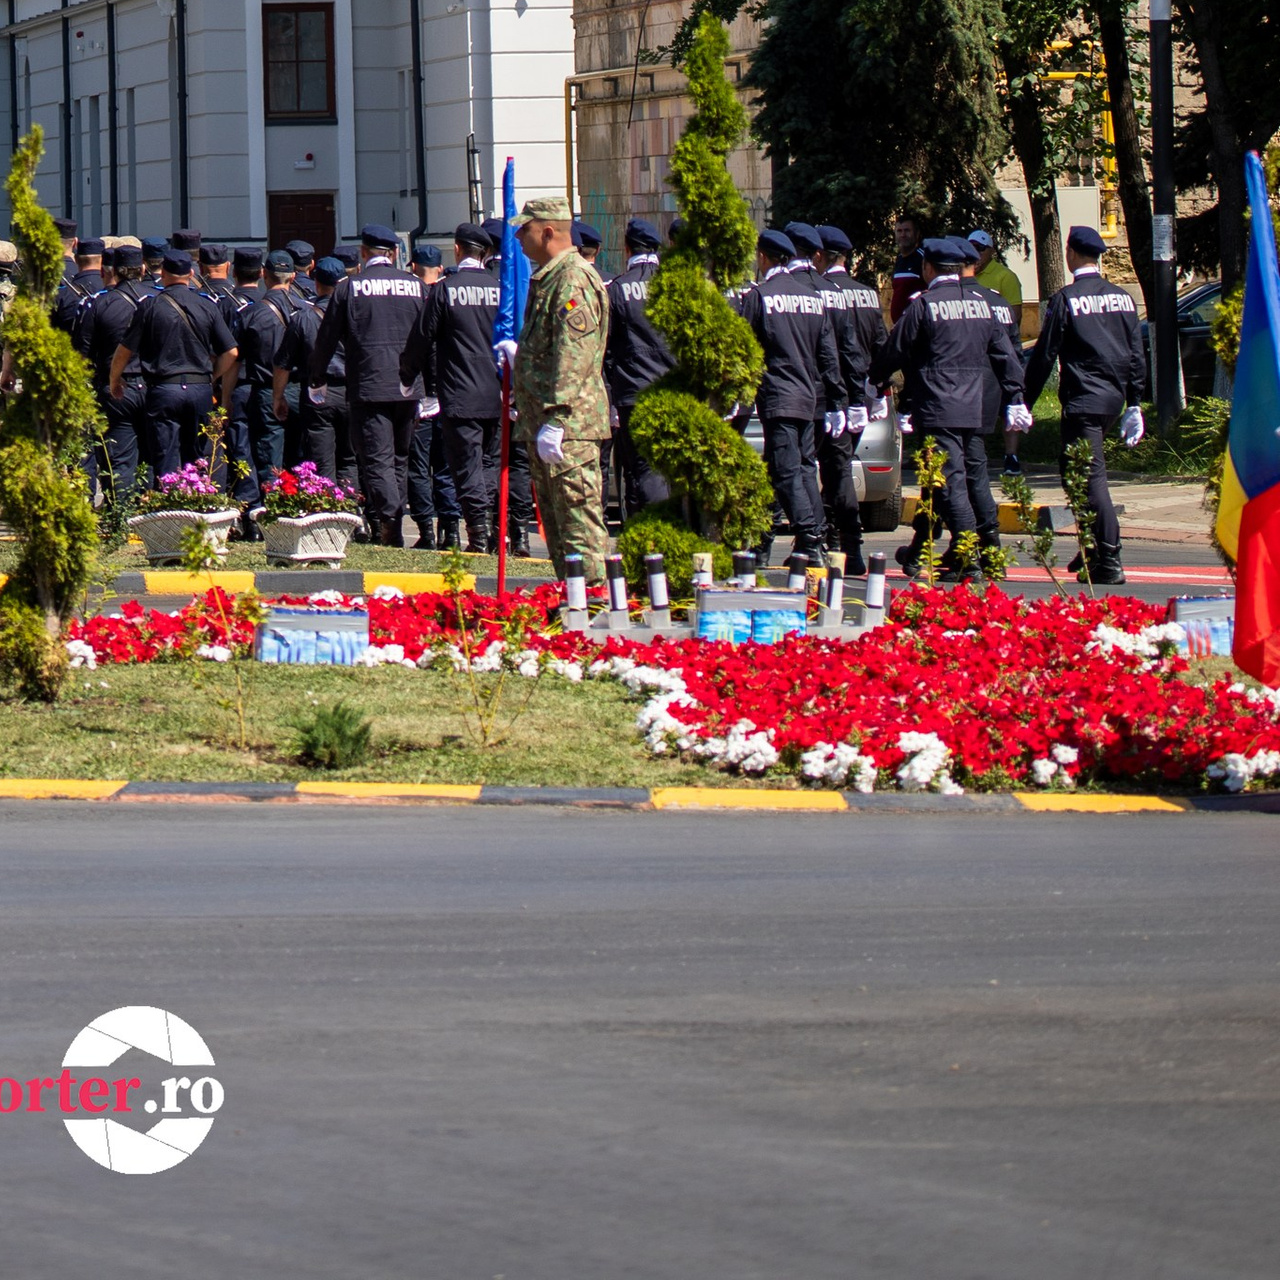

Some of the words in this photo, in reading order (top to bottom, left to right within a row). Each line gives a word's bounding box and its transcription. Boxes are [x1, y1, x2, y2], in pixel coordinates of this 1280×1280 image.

[352, 279, 421, 298] POMPIERII
[929, 300, 991, 322] POMPIERII
[1070, 293, 1135, 316] POMPIERII
